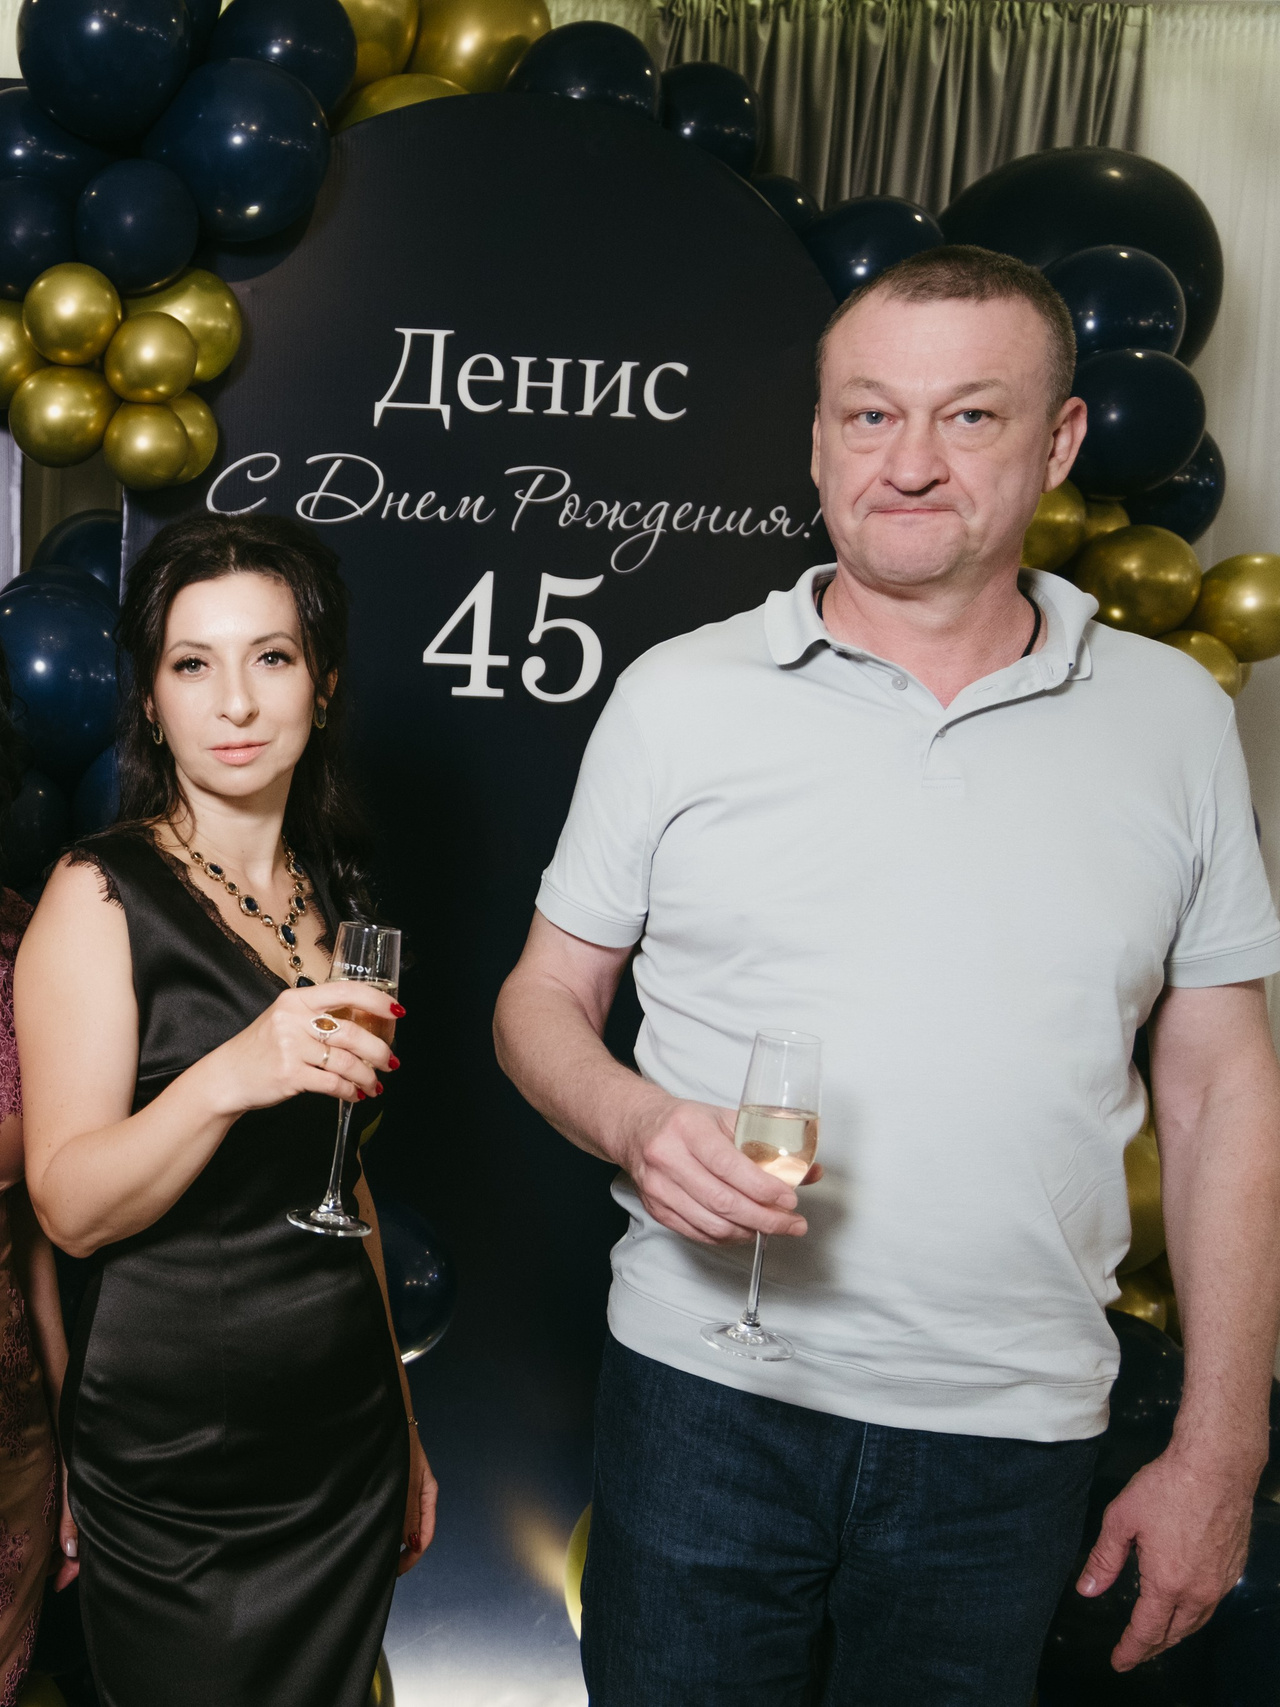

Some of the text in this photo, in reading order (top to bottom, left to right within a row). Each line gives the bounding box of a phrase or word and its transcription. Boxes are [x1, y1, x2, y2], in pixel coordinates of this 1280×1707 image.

[374, 327, 689, 430] Денис
[206, 452, 822, 573] С Днем Рождения!
[423, 570, 604, 703] 45
